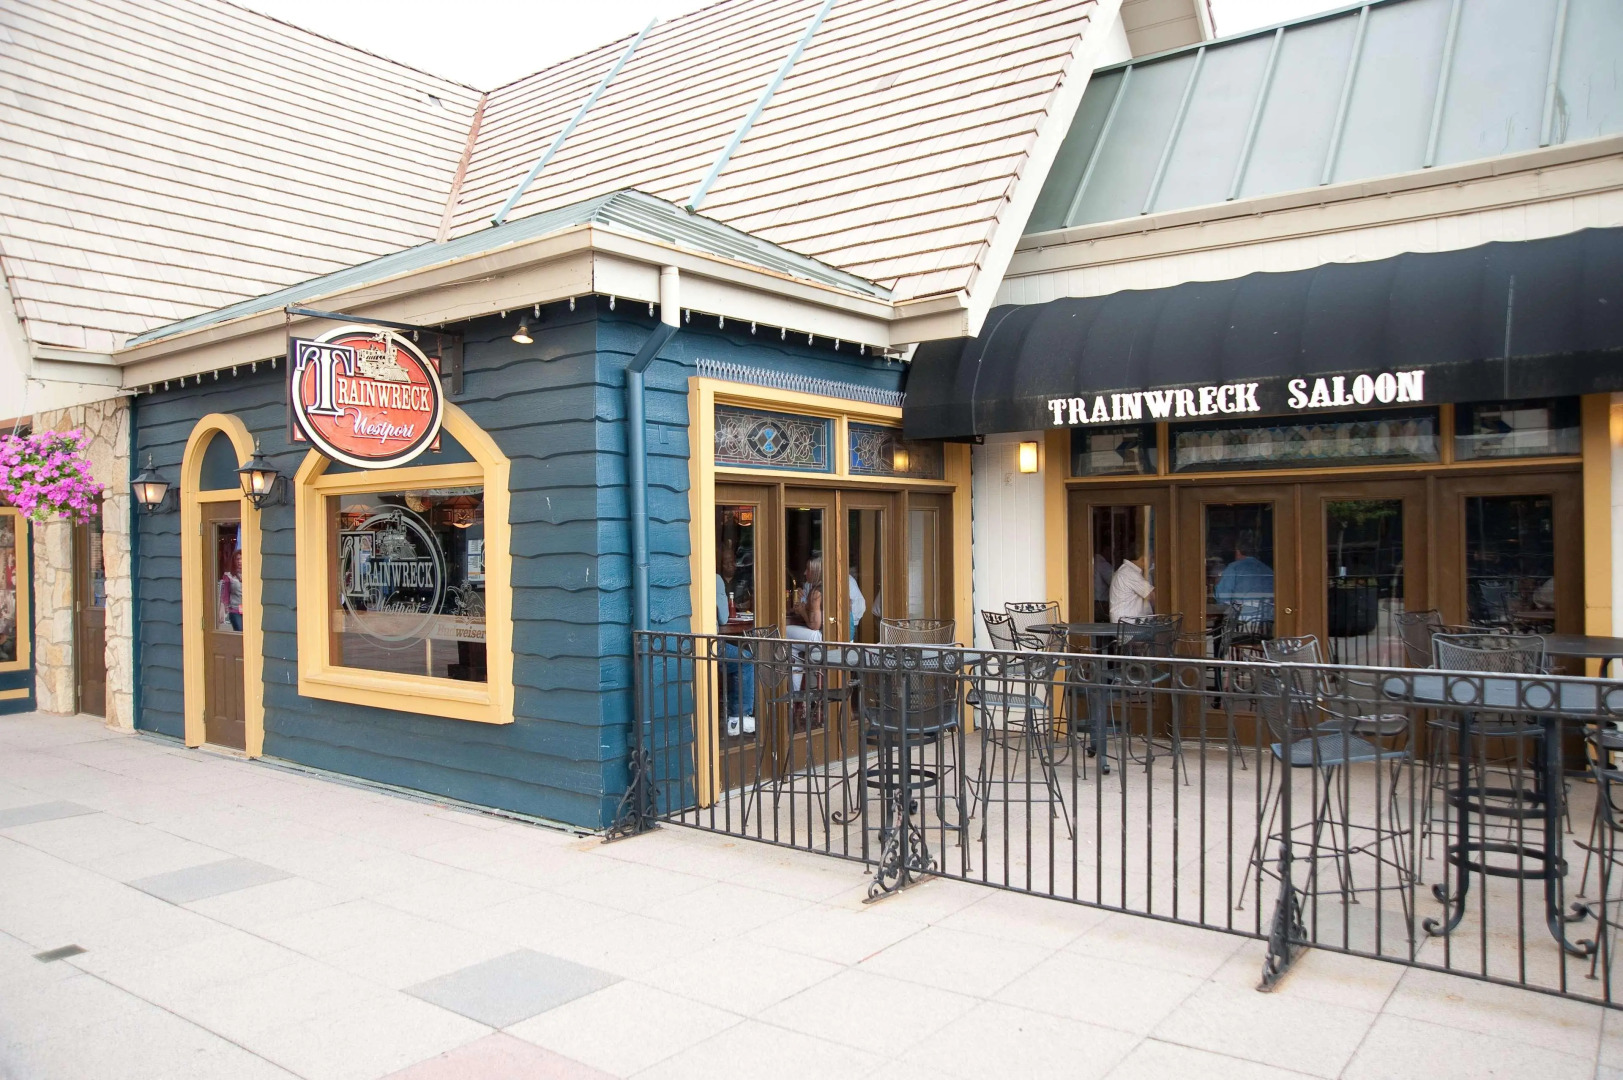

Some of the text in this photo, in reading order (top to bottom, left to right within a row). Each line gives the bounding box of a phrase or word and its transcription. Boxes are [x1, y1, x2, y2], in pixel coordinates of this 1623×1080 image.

[296, 340, 430, 416] TRAINWRECK
[1048, 370, 1425, 426] TRAINWRECK SALOON
[336, 406, 415, 444] Westport
[338, 531, 433, 597] TRAINWRECK
